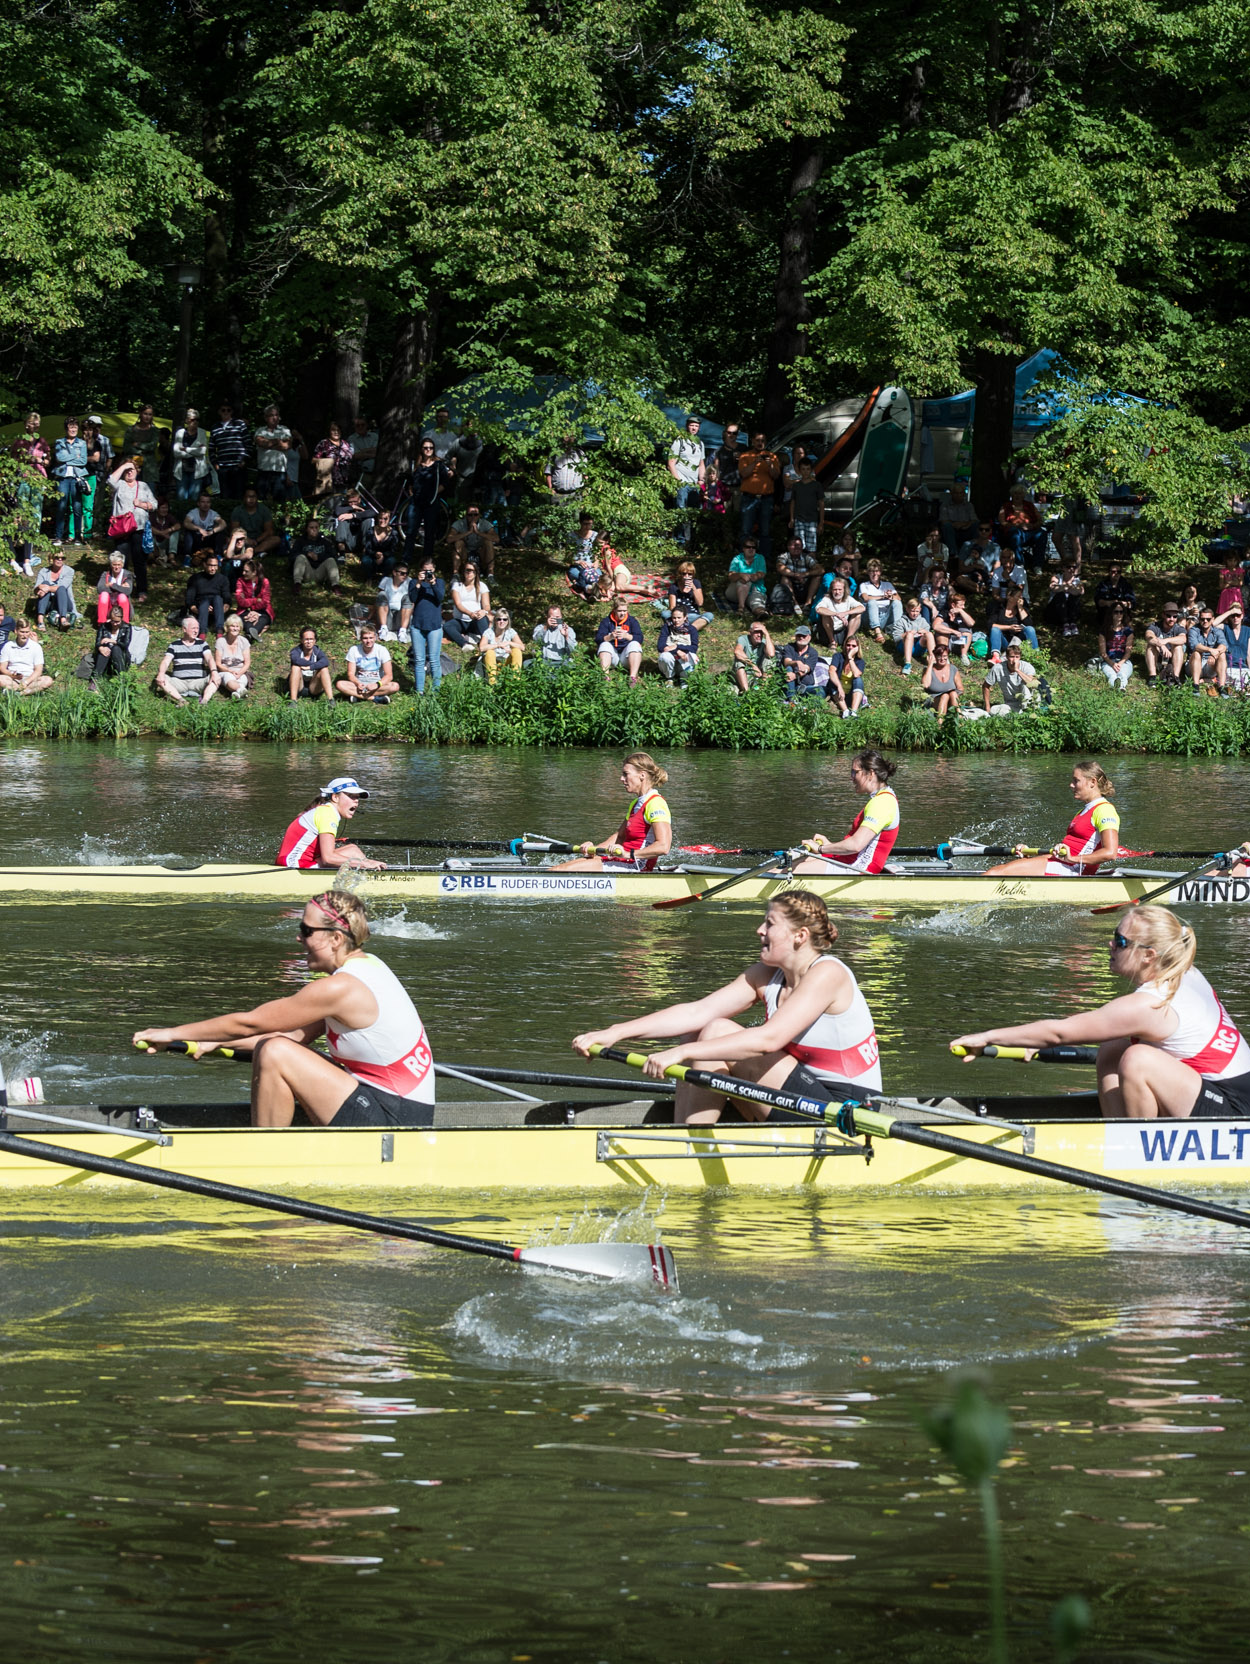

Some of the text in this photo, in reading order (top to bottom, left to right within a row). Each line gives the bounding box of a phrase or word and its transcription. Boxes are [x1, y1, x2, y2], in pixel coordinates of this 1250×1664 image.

[460, 875, 497, 888] RBL
[501, 878, 613, 890] RUDER-BUNDESLIGA
[992, 879, 1027, 896] Melitta
[857, 1036, 879, 1065] RC
[1210, 1029, 1238, 1054] RC
[403, 1046, 430, 1078] RC
[711, 1078, 822, 1115] STARK. SCHNELL. GUT. RBL
